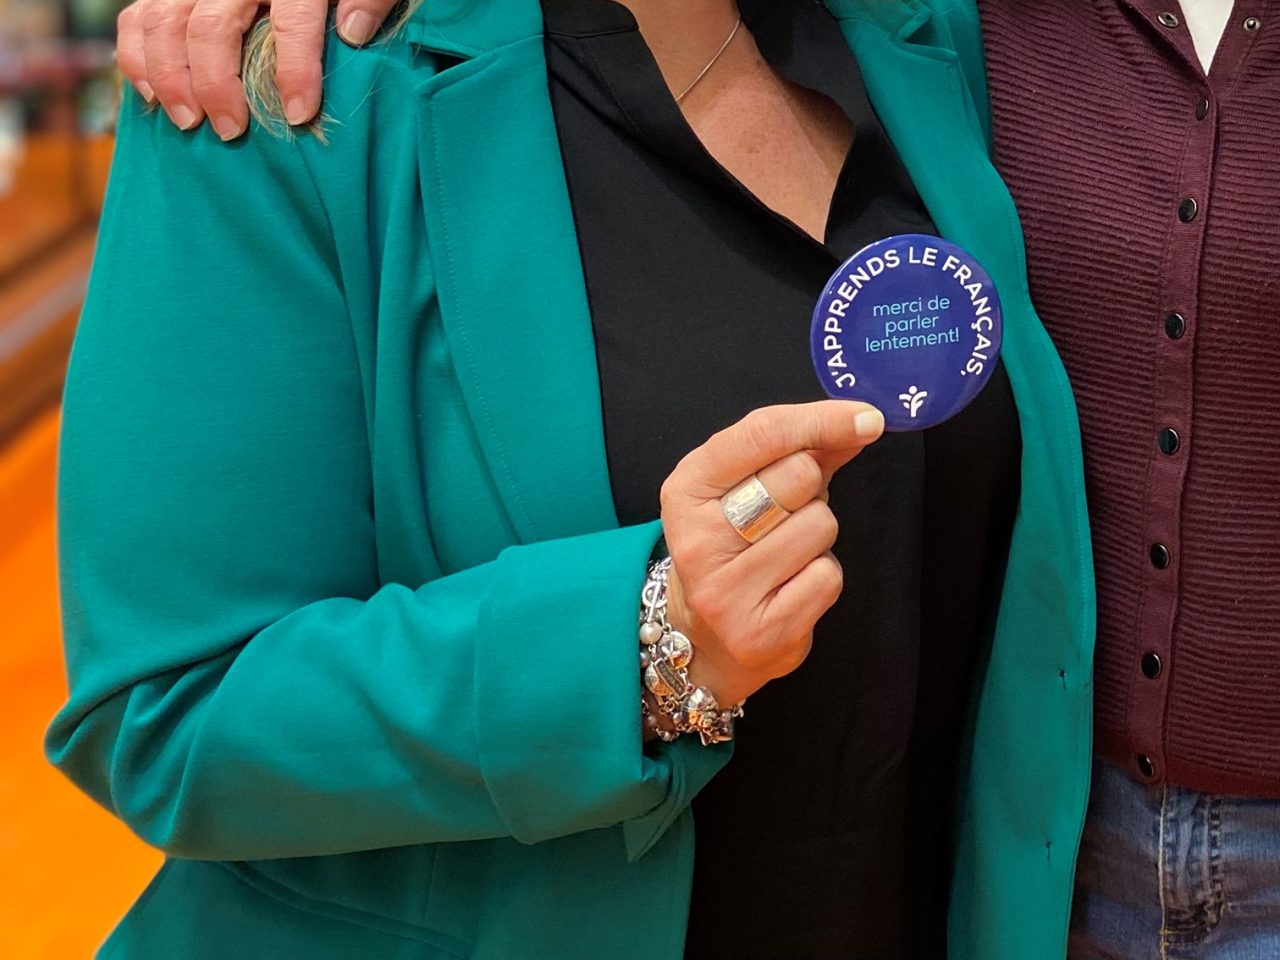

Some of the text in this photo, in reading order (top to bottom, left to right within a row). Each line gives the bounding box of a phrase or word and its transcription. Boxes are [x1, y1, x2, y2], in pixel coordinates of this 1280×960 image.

[824, 249, 900, 388] J'APPRENDS
[909, 246, 938, 266] LE
[873, 296, 950, 317] merci de
[885, 315, 940, 336] parler
[865, 327, 959, 352] lentement!
